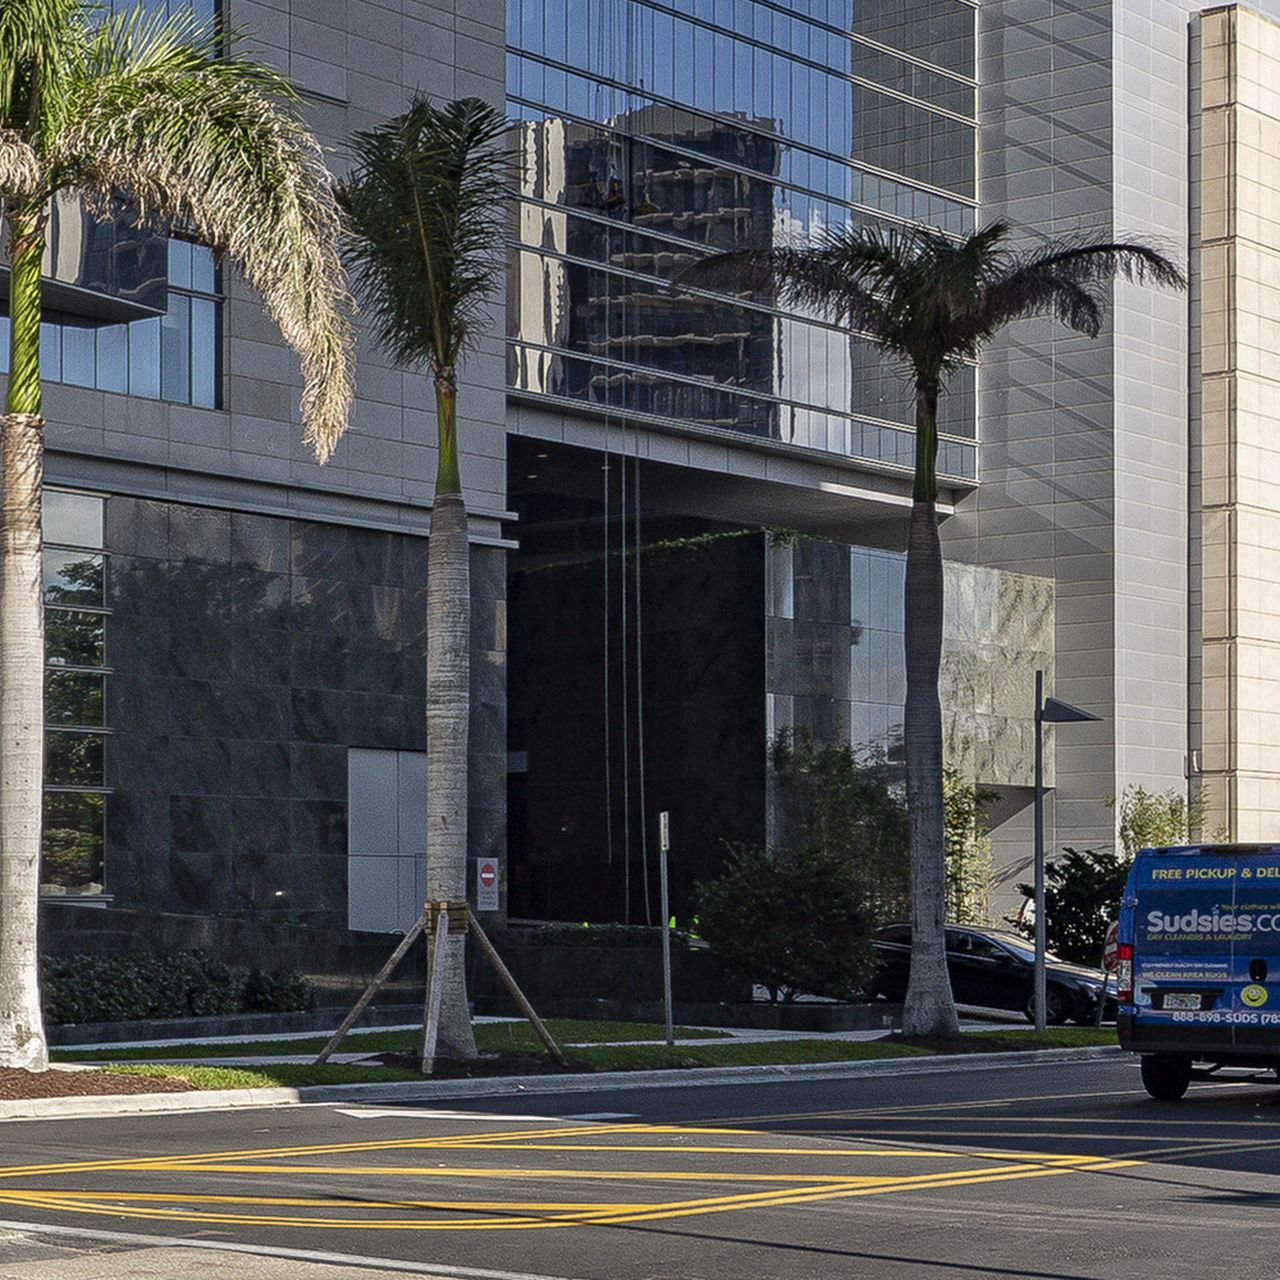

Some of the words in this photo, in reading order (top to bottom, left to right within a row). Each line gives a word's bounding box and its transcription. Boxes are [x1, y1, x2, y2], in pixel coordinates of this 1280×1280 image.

[1152, 869, 1182, 879] FREE
[1186, 868, 1237, 879] PICKUP
[1241, 867, 1252, 878] &
